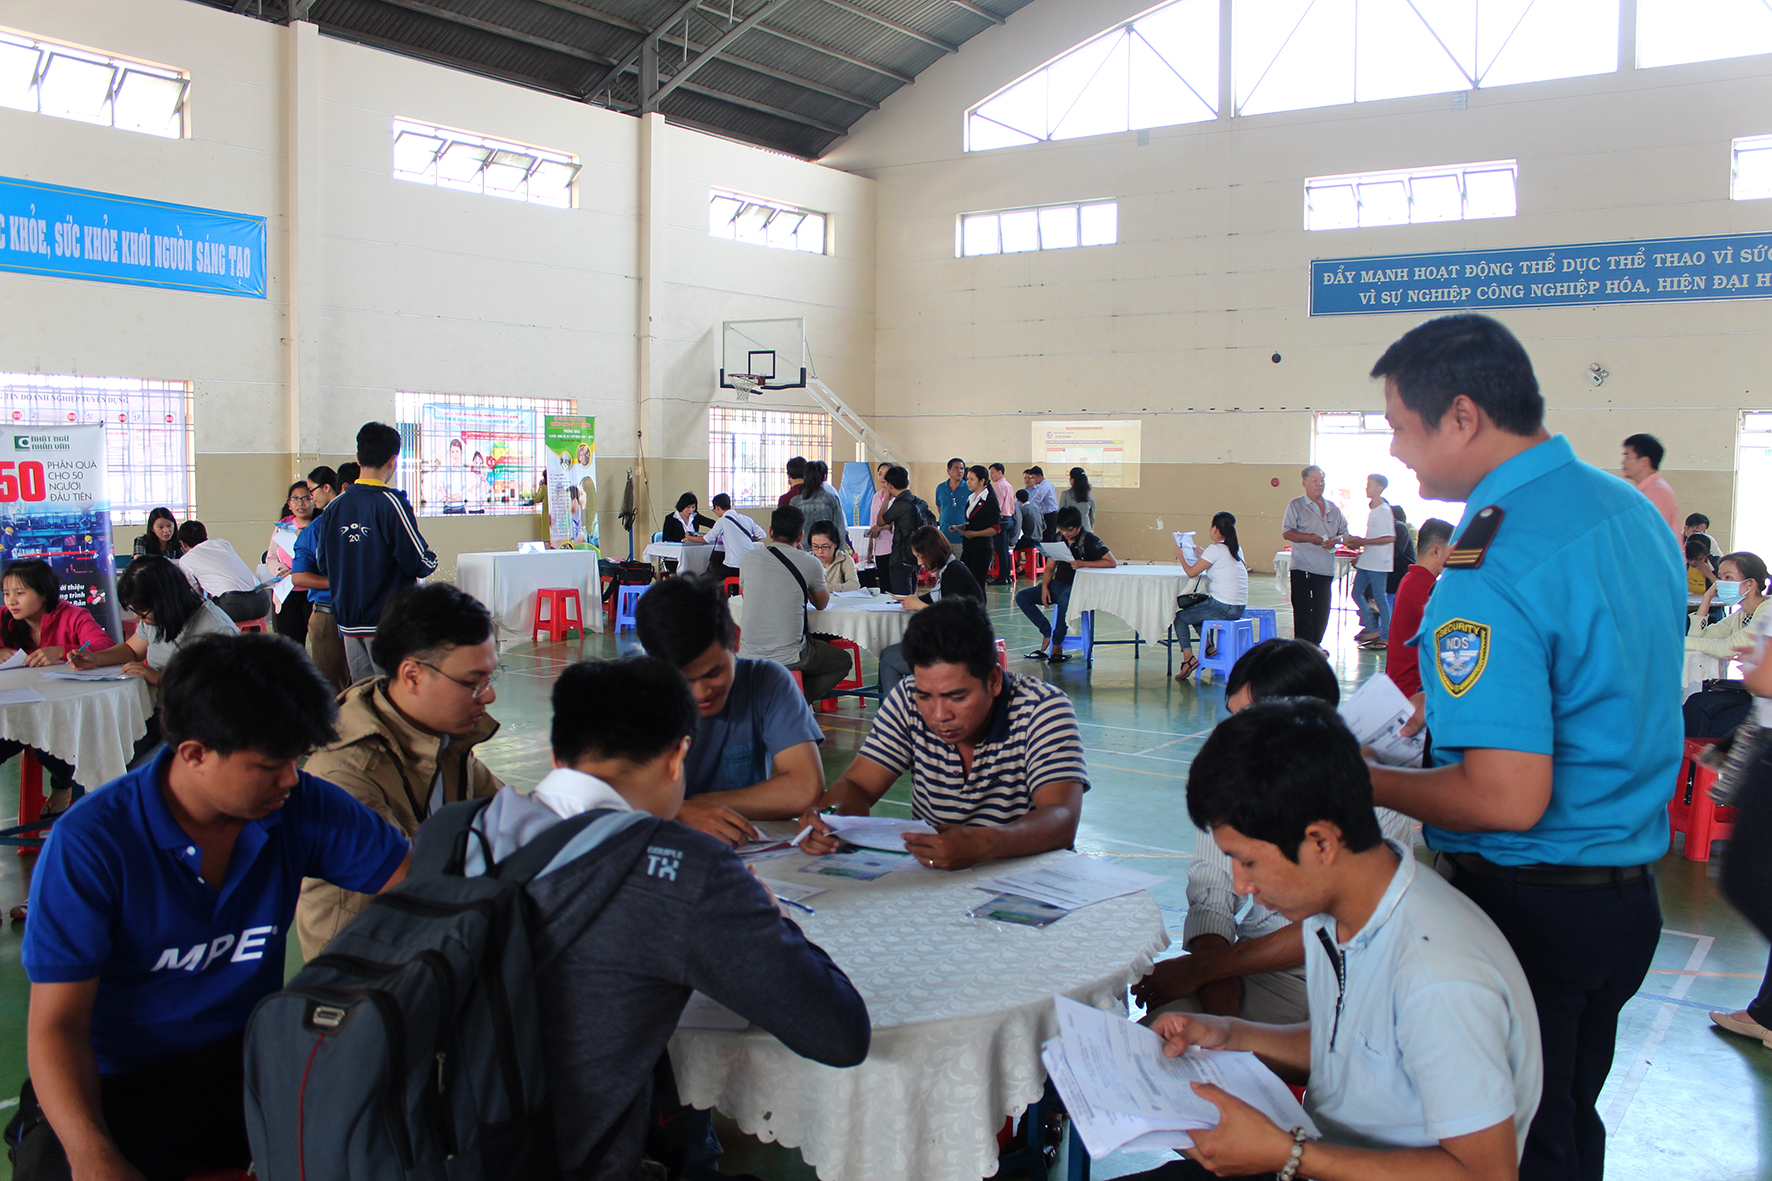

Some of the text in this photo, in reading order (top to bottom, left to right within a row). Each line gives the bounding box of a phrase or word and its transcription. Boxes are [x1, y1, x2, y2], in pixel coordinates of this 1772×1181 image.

[9, 203, 51, 260] KHỎE,
[54, 214, 81, 258] SỨC
[83, 213, 119, 262] KHỎE
[121, 226, 151, 267] KHƠI
[154, 225, 193, 272] NGUỒN
[196, 234, 226, 275] SÁNG
[228, 245, 251, 285] TẠO
[1323, 265, 1356, 285] ĐẨY
[1360, 268, 1409, 285] MẠNH
[1413, 265, 1460, 281] HOẠT
[1465, 261, 1514, 280] ĐỘNG
[1519, 253, 1556, 275] THỂ
[1562, 257, 1601, 275] DỤC
[1607, 247, 1646, 270] THỂ
[1652, 251, 1706, 268] THAO
[1712, 246, 1734, 264] VÌ
[1359, 289, 1376, 305] VÌ
[1381, 289, 1403, 306] SỰ
[1407, 285, 1472, 303] NGHIỆP
[1476, 283, 1525, 299] CÔNG
[1530, 278, 1600, 298] NGHIỆP
[1605, 276, 1651, 294] HÓA,
[1657, 273, 1707, 293] HIỆN
[1713, 274, 1750, 292] ĐẠI
[20, 393, 50, 402] DOANH
[75, 460, 97, 470] QUÀ
[0, 461, 46, 502] 50
[48, 471, 84, 480] CHO 50
[49, 481, 81, 491] NGƯỜI
[1440, 622, 1480, 637] SECURITY
[1447, 637, 1470, 650] NDS
[150, 925, 273, 972] MPE
